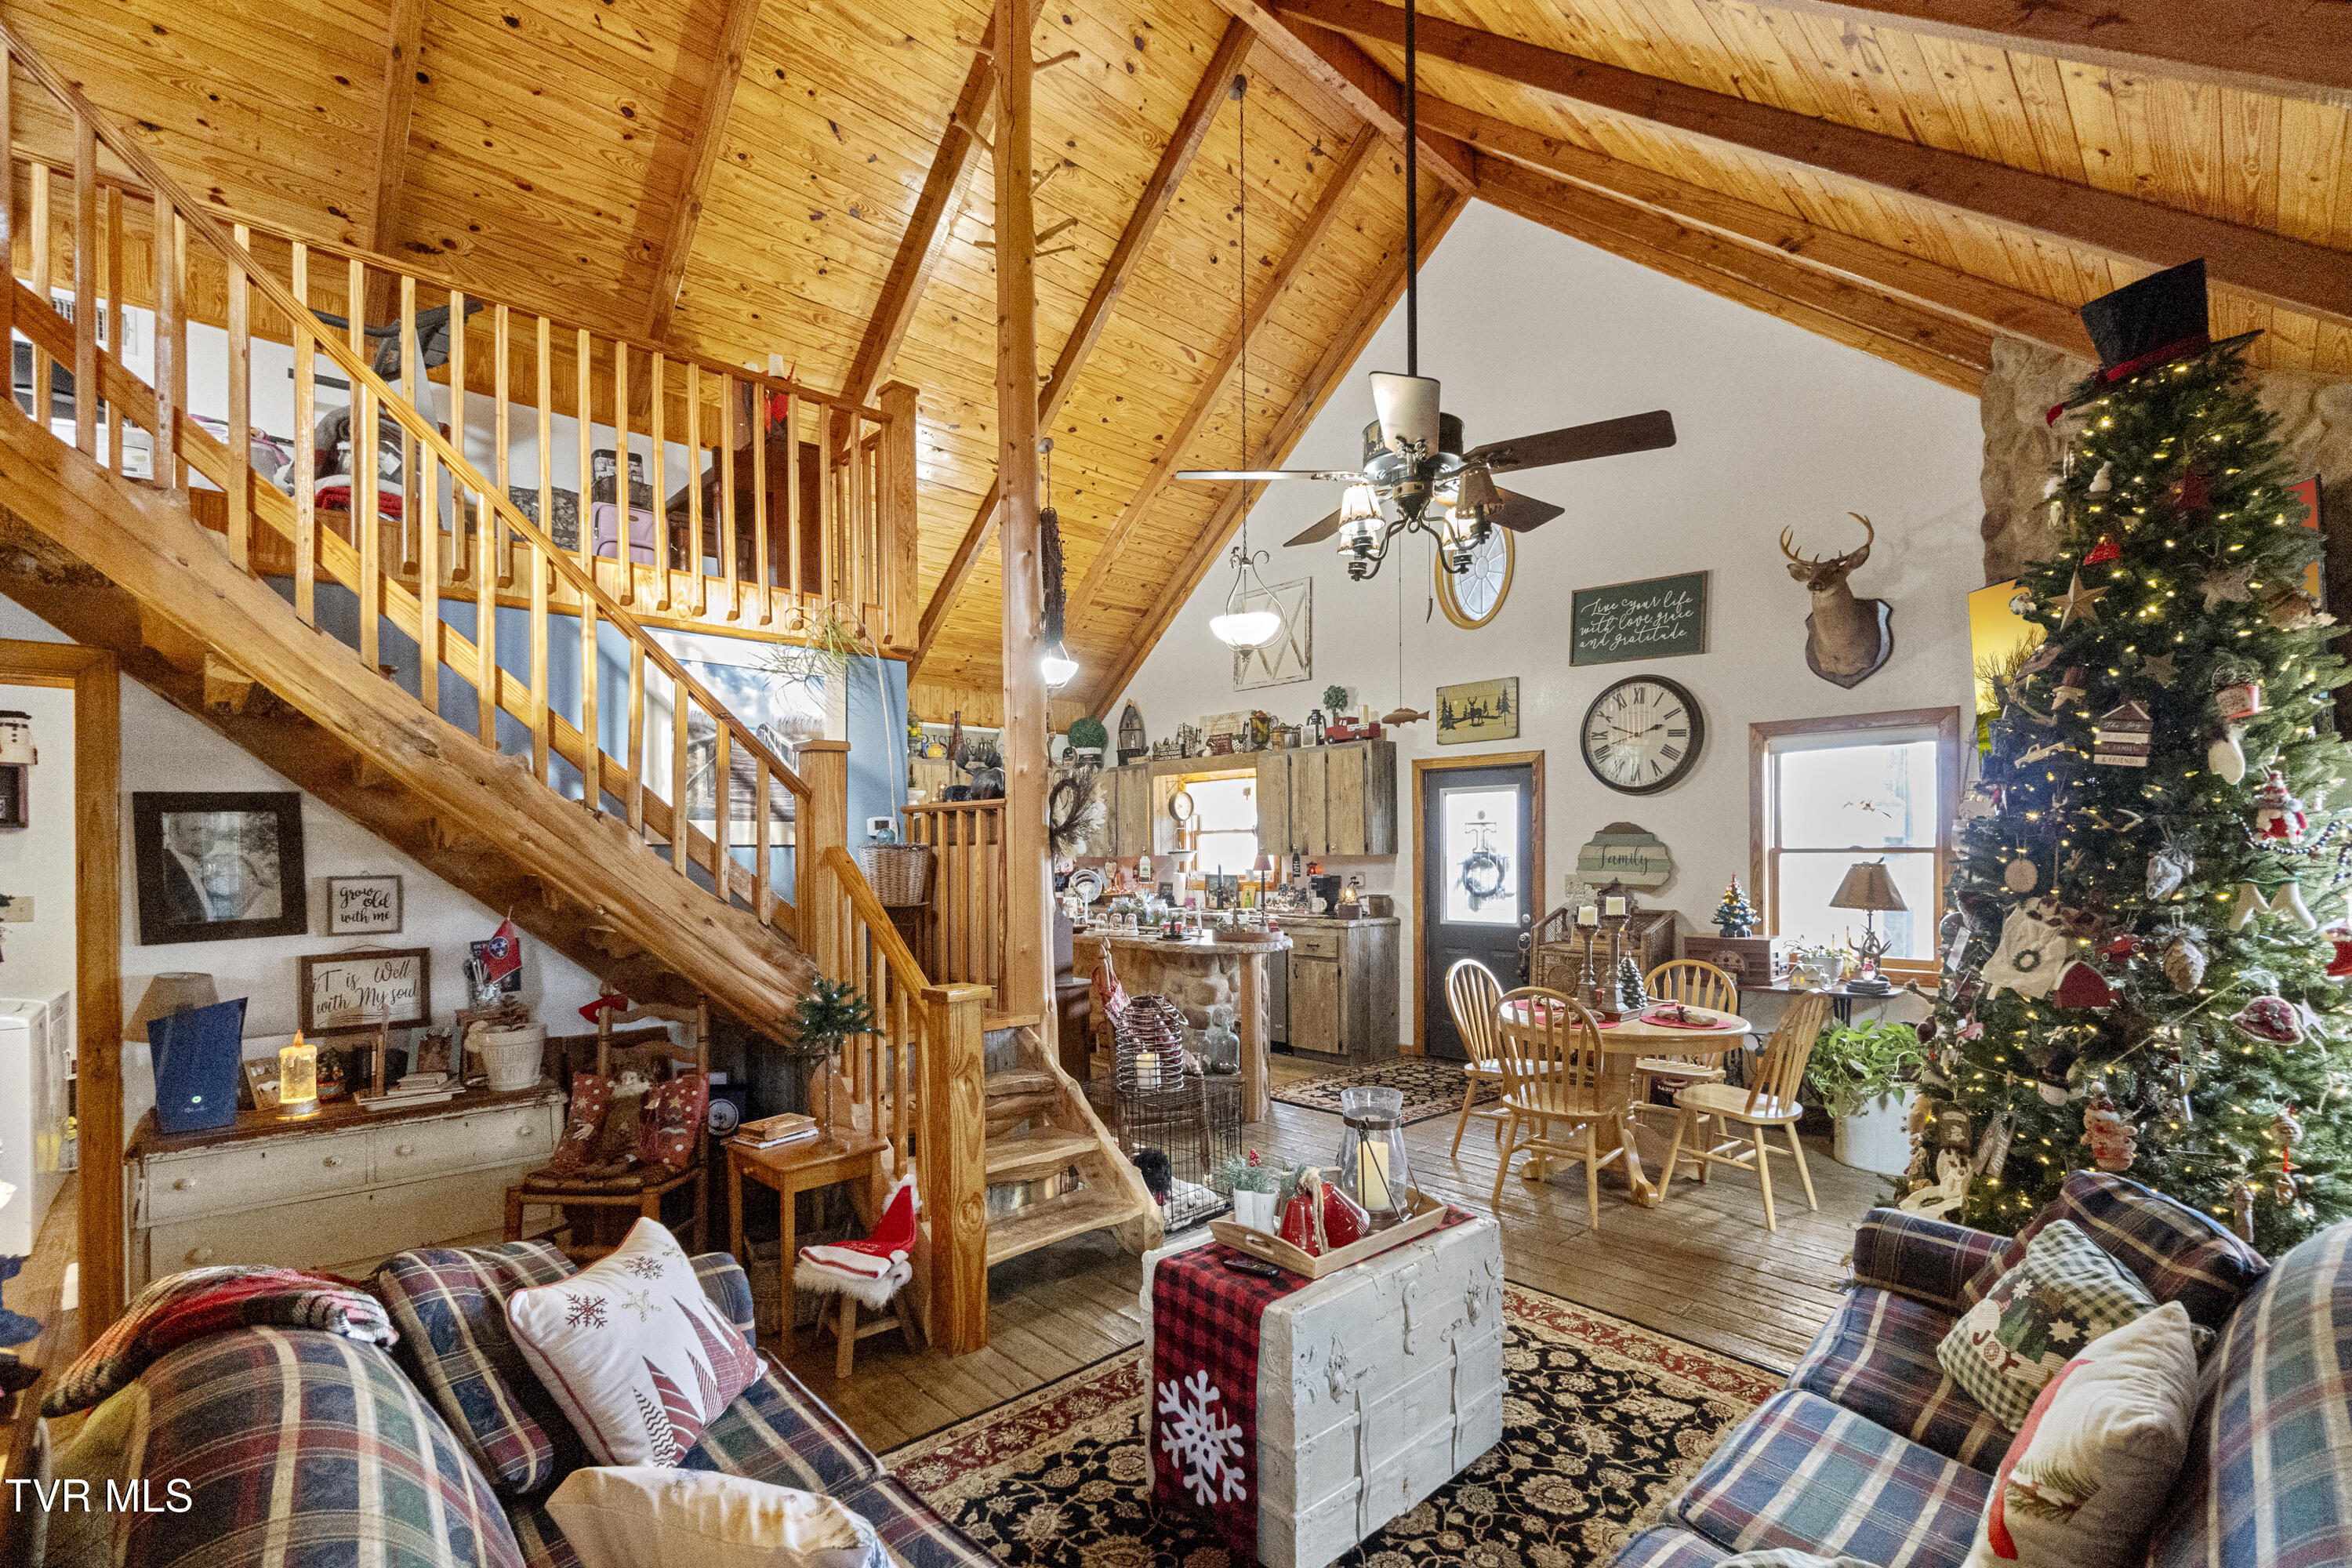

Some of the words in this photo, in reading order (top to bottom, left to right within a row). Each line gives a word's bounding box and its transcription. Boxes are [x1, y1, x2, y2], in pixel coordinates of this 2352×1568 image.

[1581, 598, 1619, 616] Live
[1621, 597, 1661, 615] your
[1664, 590, 1693, 613] life
[1580, 633, 1610, 649] and
[1610, 622, 1687, 651] gratitude
[1581, 615, 1617, 636] with
[1653, 610, 1694, 626] grace
[1596, 844, 1650, 876] Family
[339, 887, 376, 909] grow
[363, 890, 390, 908] old
[341, 907, 368, 924] with
[373, 910, 391, 922] me
[346, 972, 360, 990] is
[374, 959, 411, 982] Well
[317, 993, 351, 1014] with
[354, 986, 387, 1010] My
[391, 978, 417, 1004] soul
[1973, 1330, 2020, 1374] JOY
